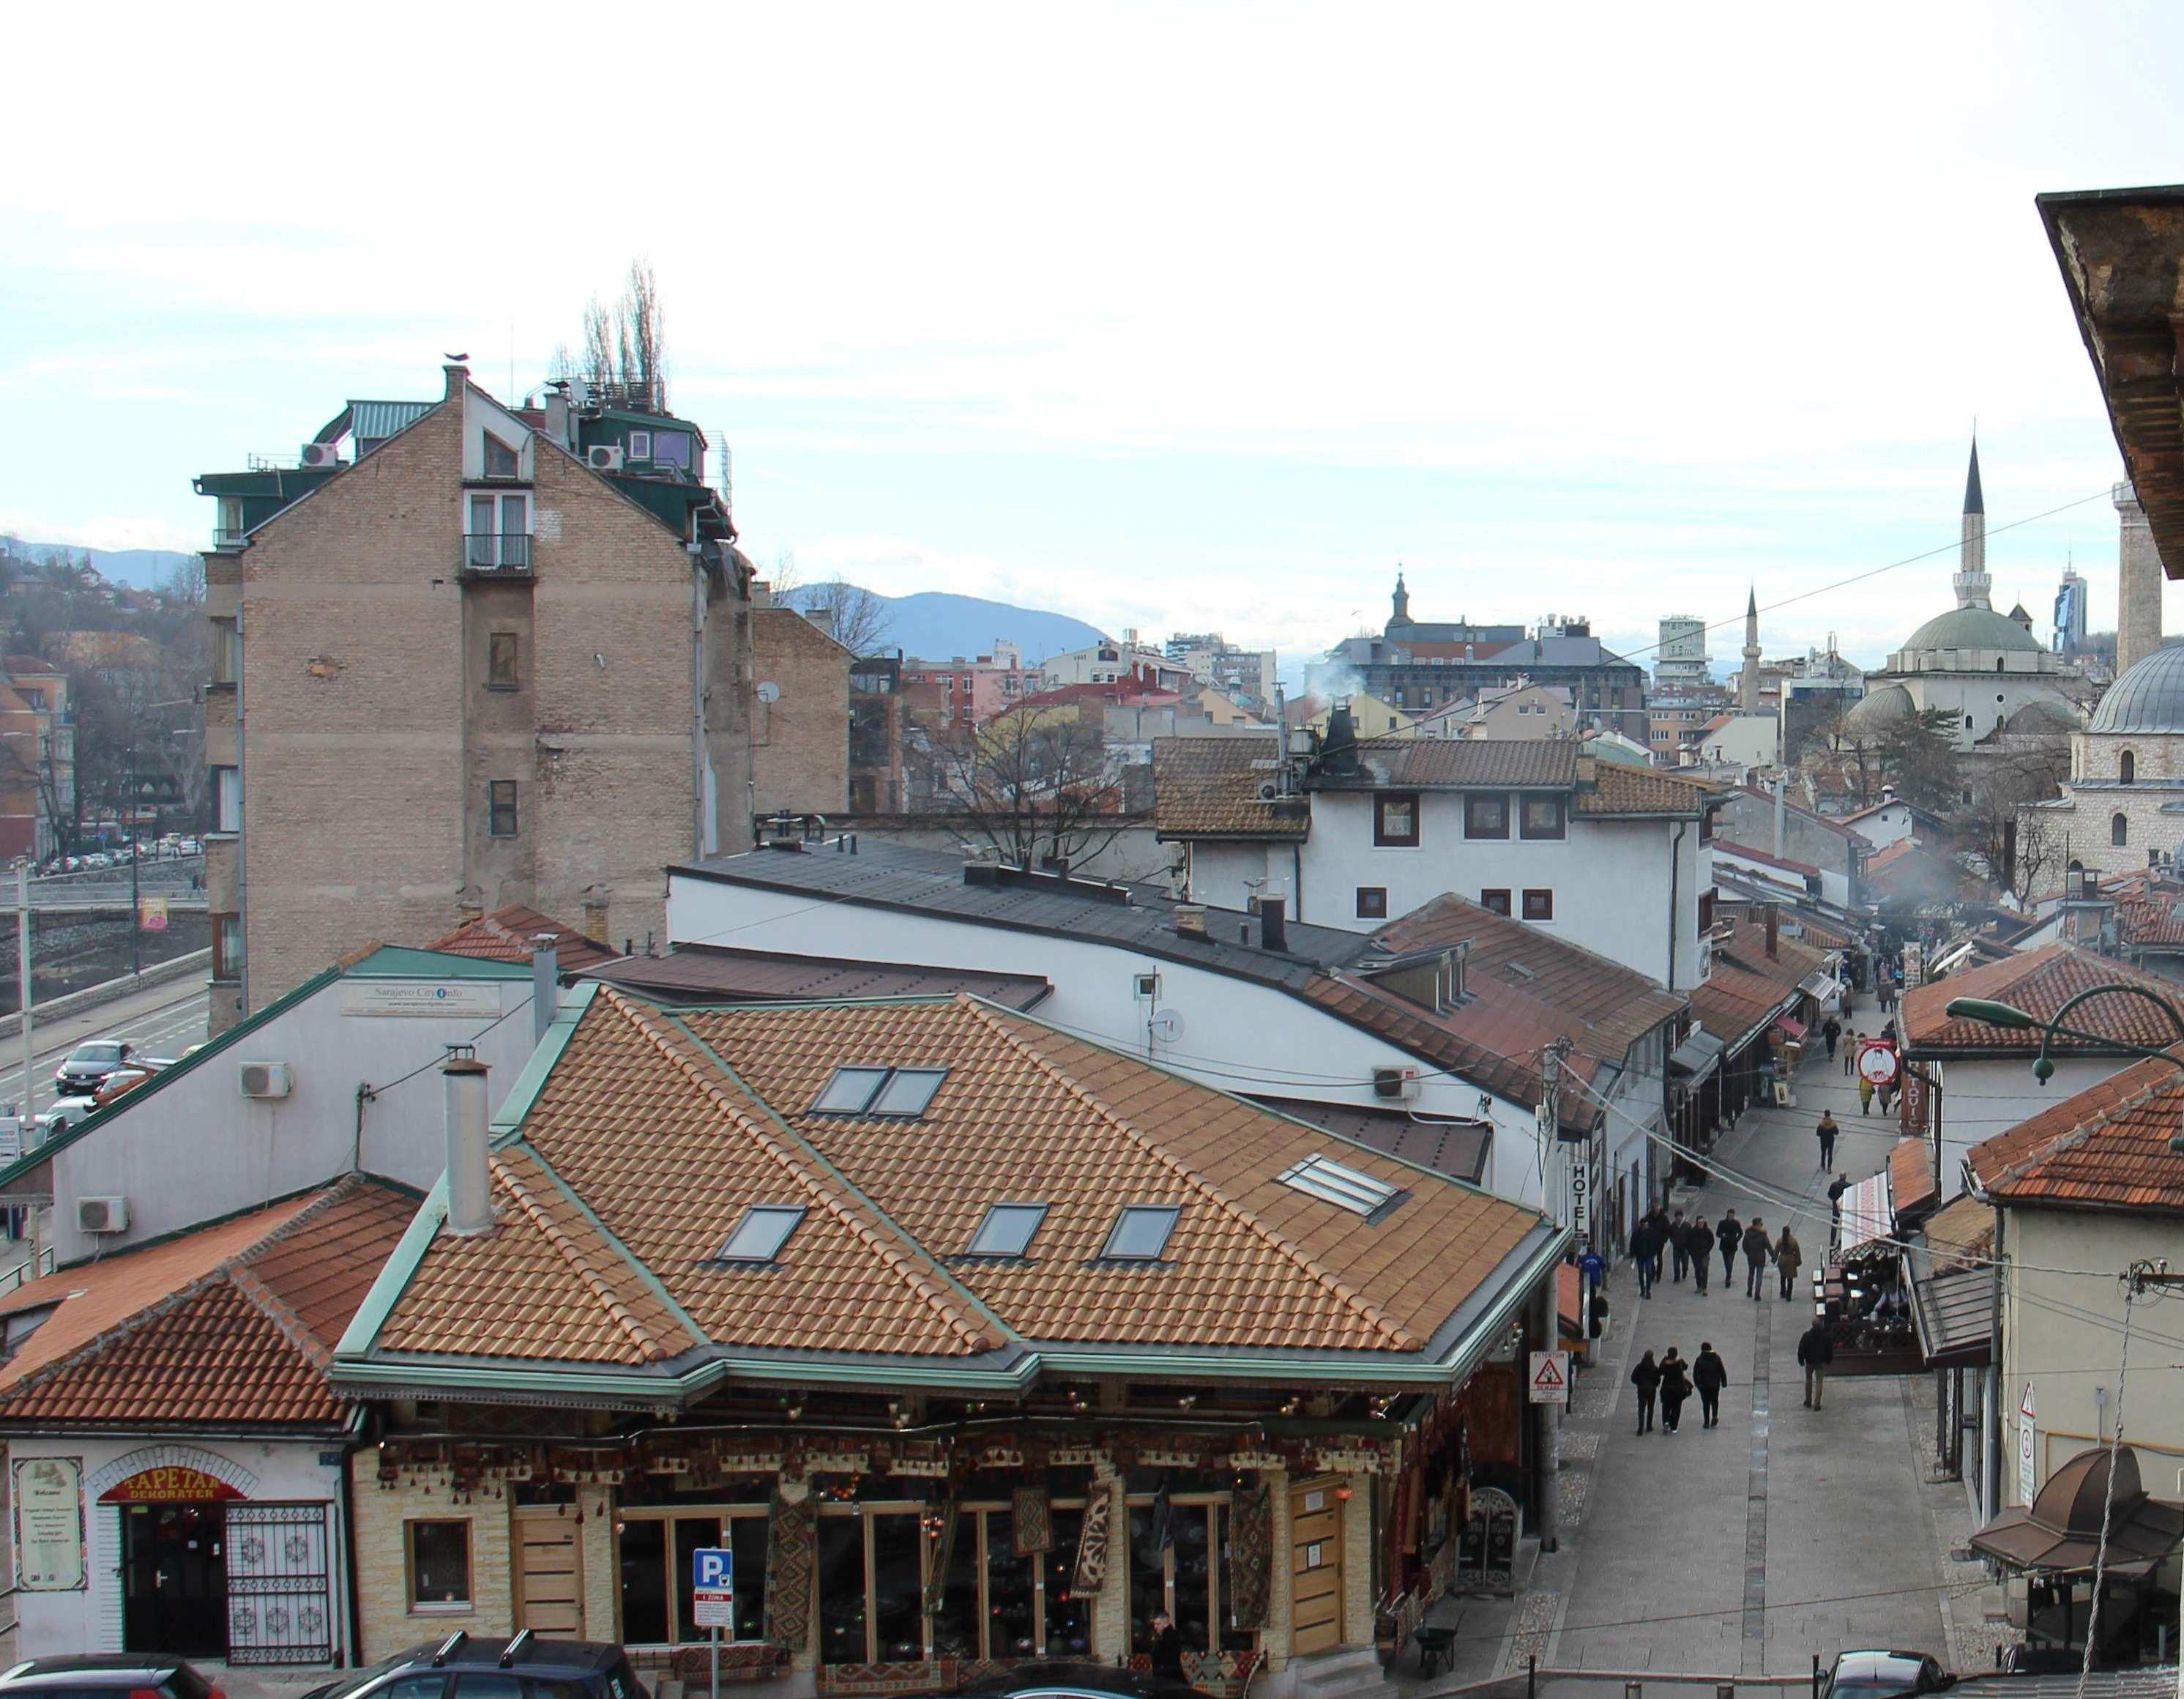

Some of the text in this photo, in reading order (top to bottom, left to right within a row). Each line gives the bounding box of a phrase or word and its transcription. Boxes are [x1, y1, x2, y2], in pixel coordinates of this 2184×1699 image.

[376, 988, 414, 998] Sarajevo
[417, 988, 436, 999] City
[1573, 1165, 1586, 1233] HOTEL
[124, 1468, 220, 1490] TAPETAR
[130, 1490, 215, 1499] DEKORATER
[703, 1555, 723, 1583] P
